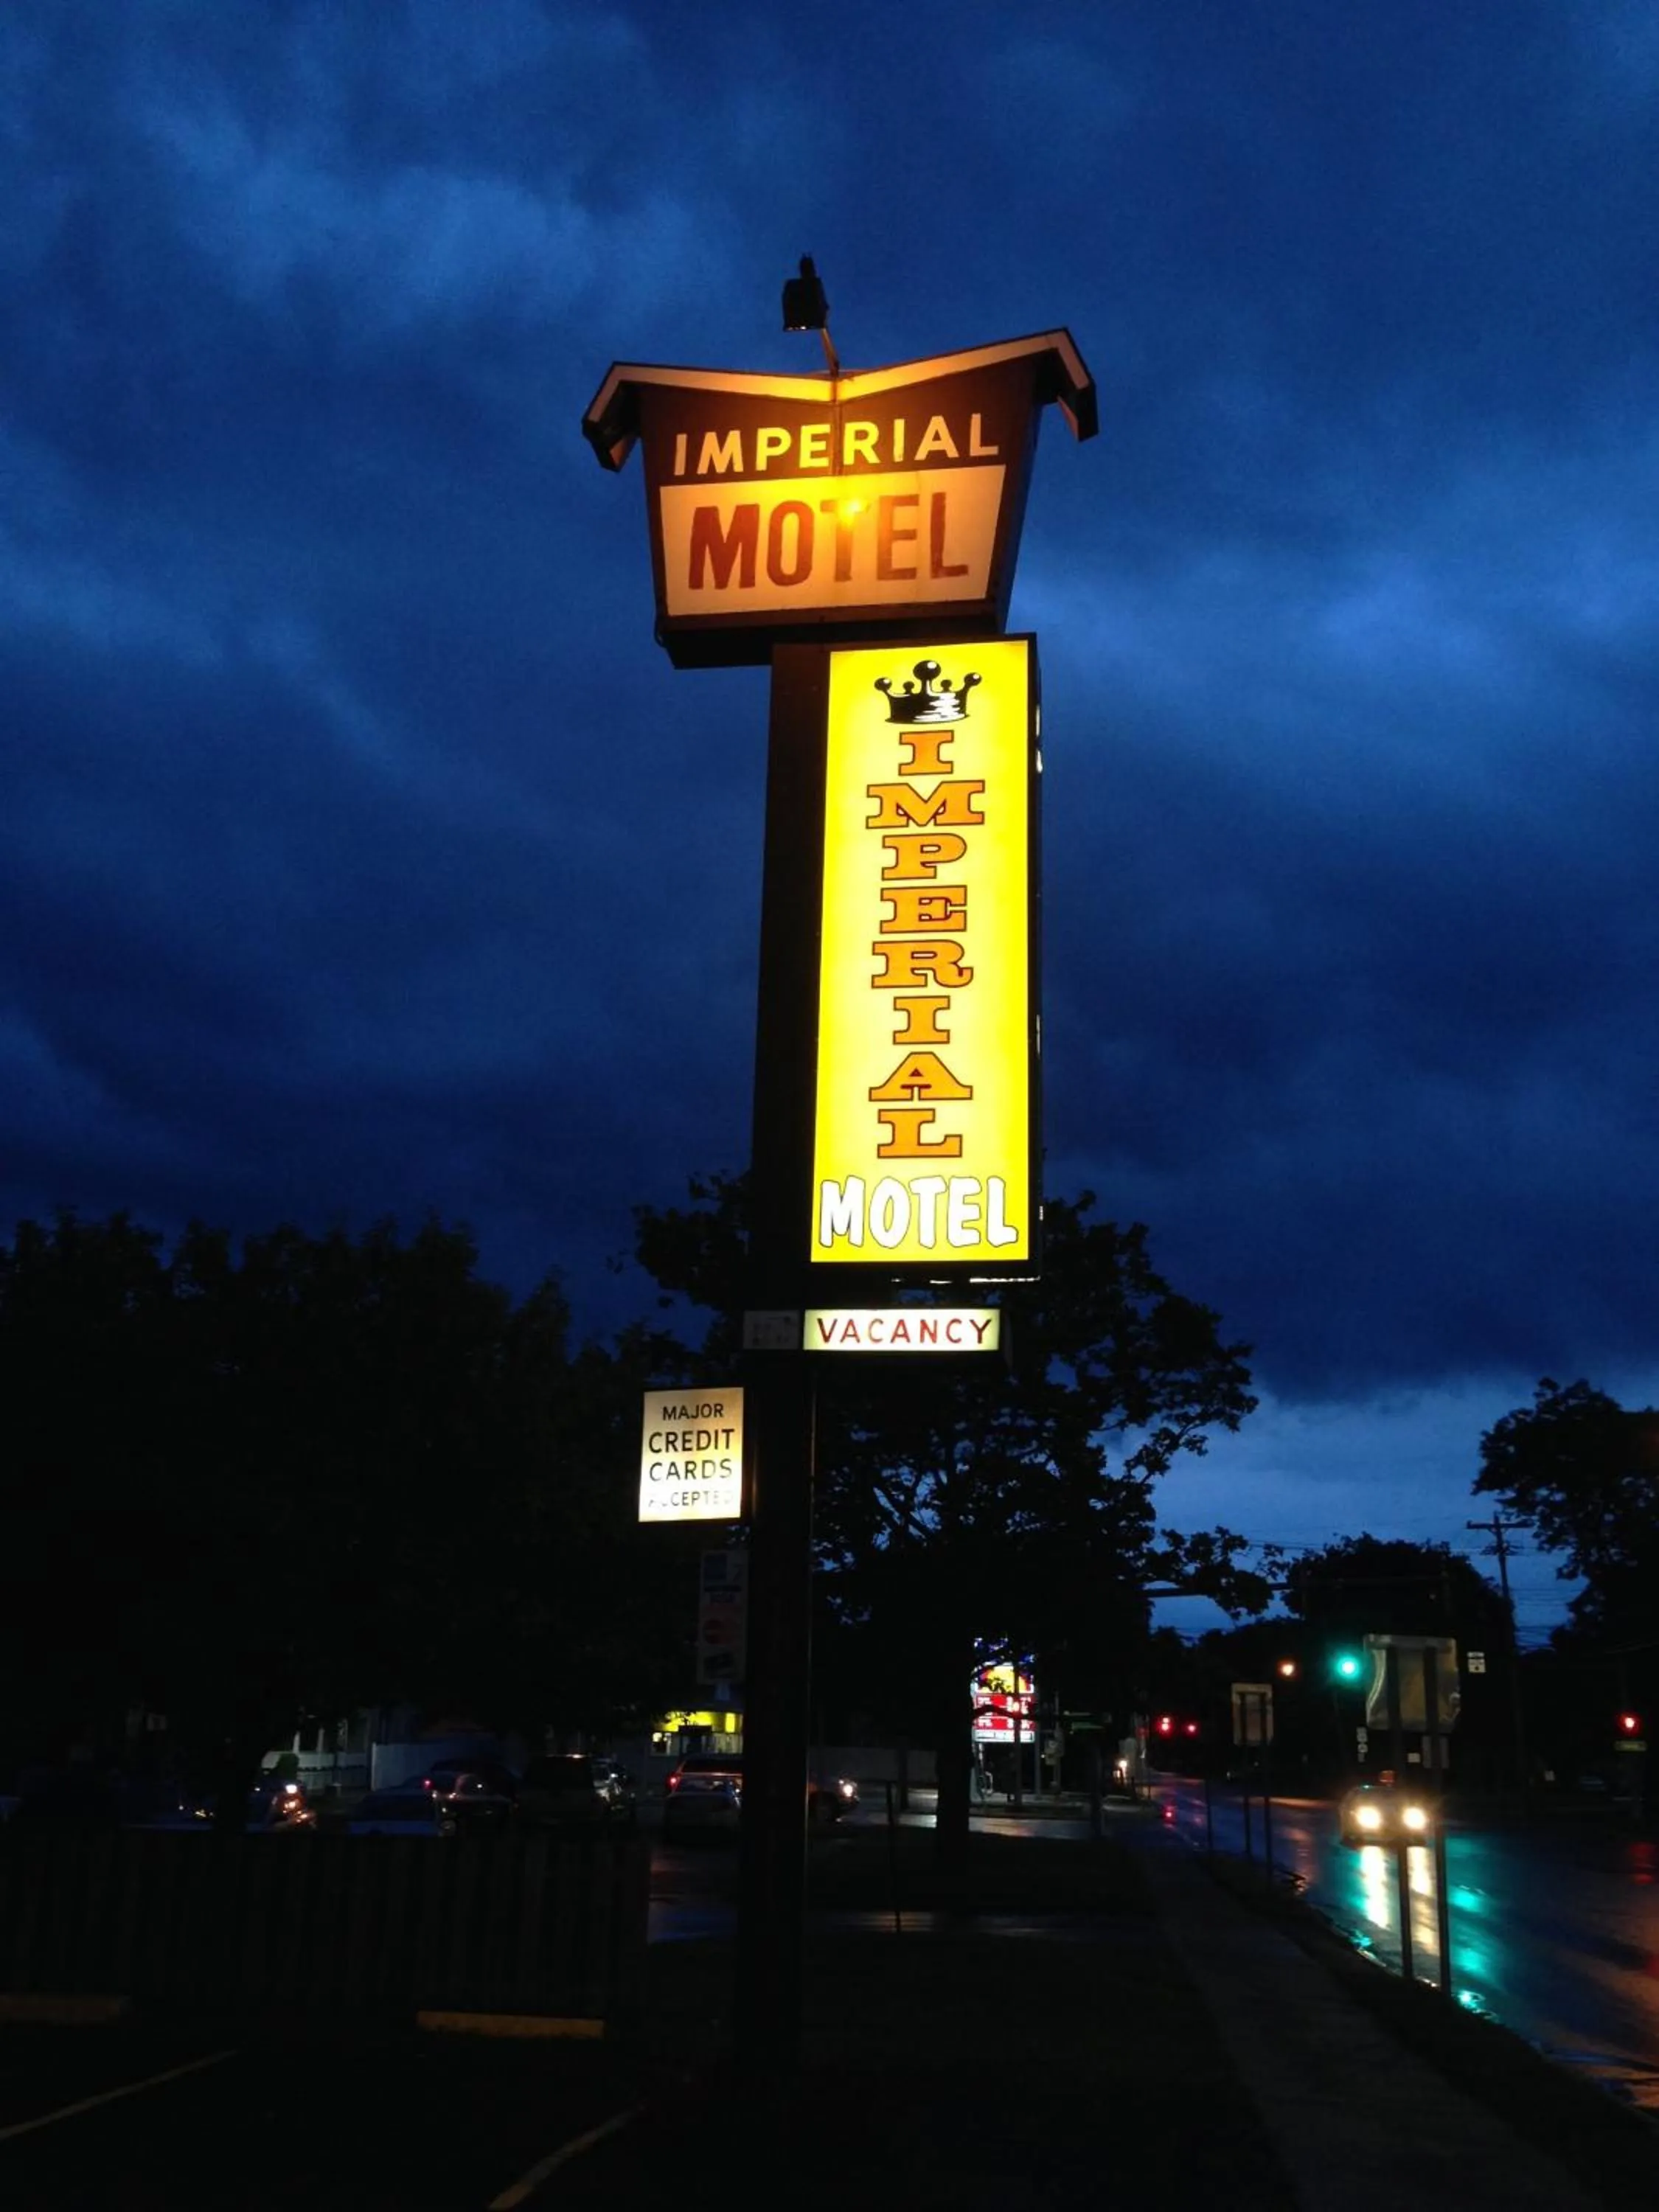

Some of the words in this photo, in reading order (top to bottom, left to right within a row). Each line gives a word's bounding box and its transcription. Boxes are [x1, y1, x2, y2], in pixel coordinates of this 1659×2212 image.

[674, 413, 999, 476] IMPERIAL
[688, 492, 968, 590] MOTEL
[866, 730, 985, 1158] IMPERIAL
[818, 1175, 1019, 1249] MOTEL
[817, 1318, 992, 1344] VACANCY
[663, 1403, 723, 1421] MAJOR
[648, 1428, 734, 1453] CREDIT
[649, 1458, 732, 1481] CARDS
[648, 1490, 733, 1508] CEPTE
